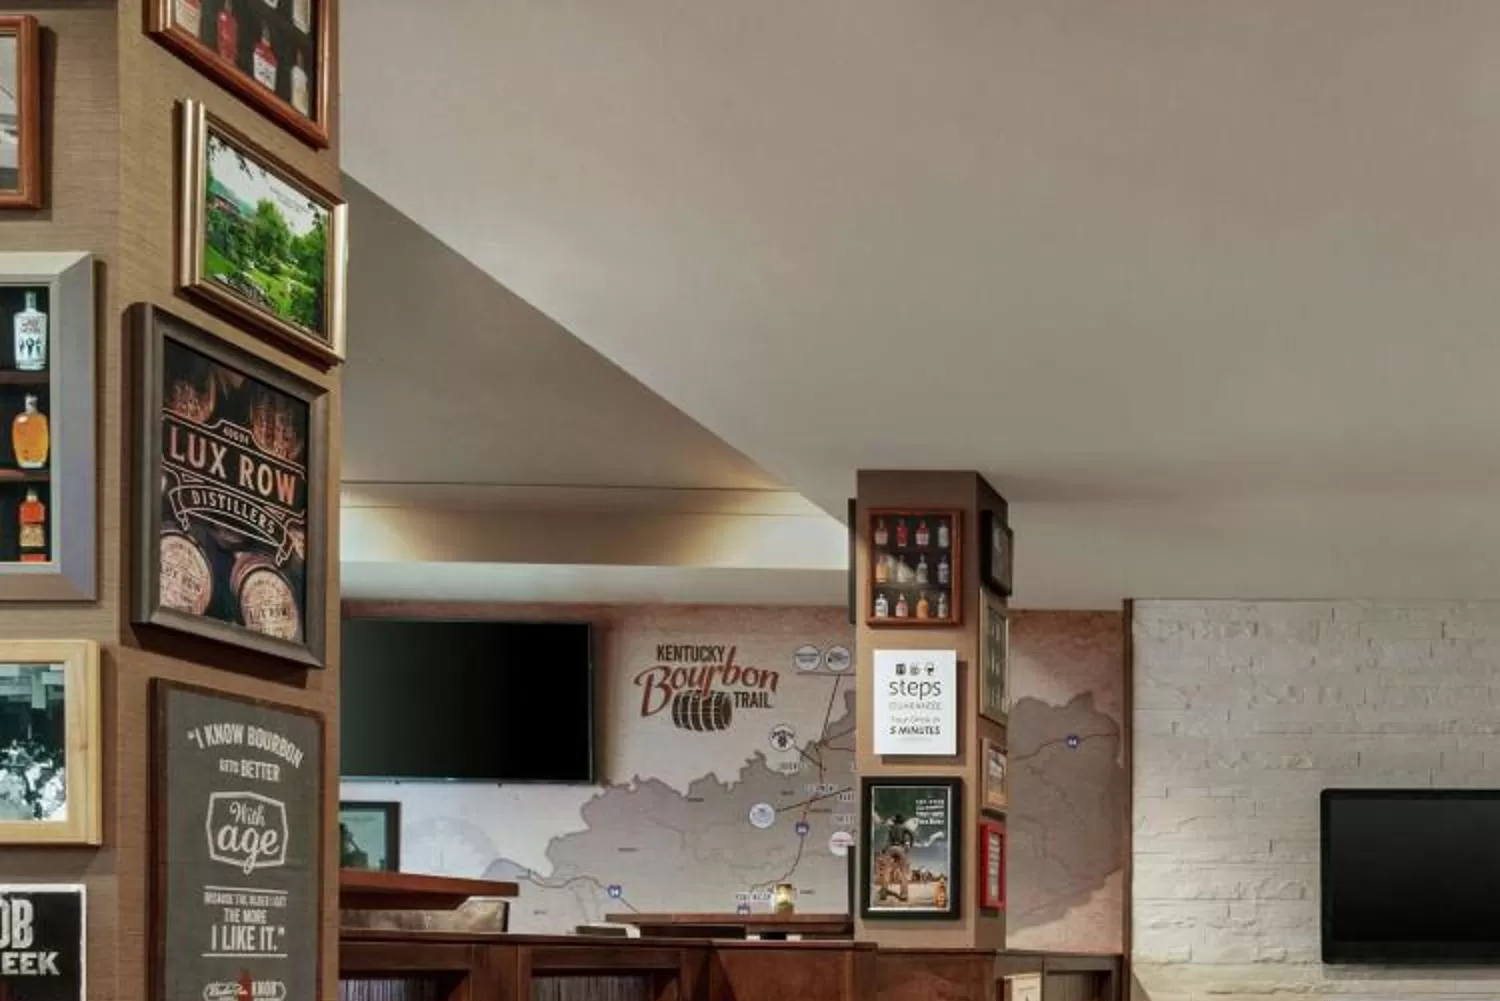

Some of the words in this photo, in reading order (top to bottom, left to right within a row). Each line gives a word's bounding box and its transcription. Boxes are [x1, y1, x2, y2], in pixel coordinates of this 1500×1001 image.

[169, 426, 228, 479] LUX
[239, 454, 296, 506] ROW
[191, 489, 275, 535] DISTILLERS
[656, 644, 727, 664] KENTUCKY
[633, 645, 780, 718] Bourbon
[889, 680, 942, 700] steps
[898, 725, 942, 735] MINUTES
[203, 722, 245, 747] KNOW
[247, 725, 305, 769] BOURBON
[240, 758, 281, 782] BETTER
[228, 801, 266, 828] With
[217, 824, 280, 875] age
[224, 907, 241, 923] THE
[242, 909, 268, 925] MORE
[211, 924, 217, 951] I
[221, 924, 256, 951] LIKE
